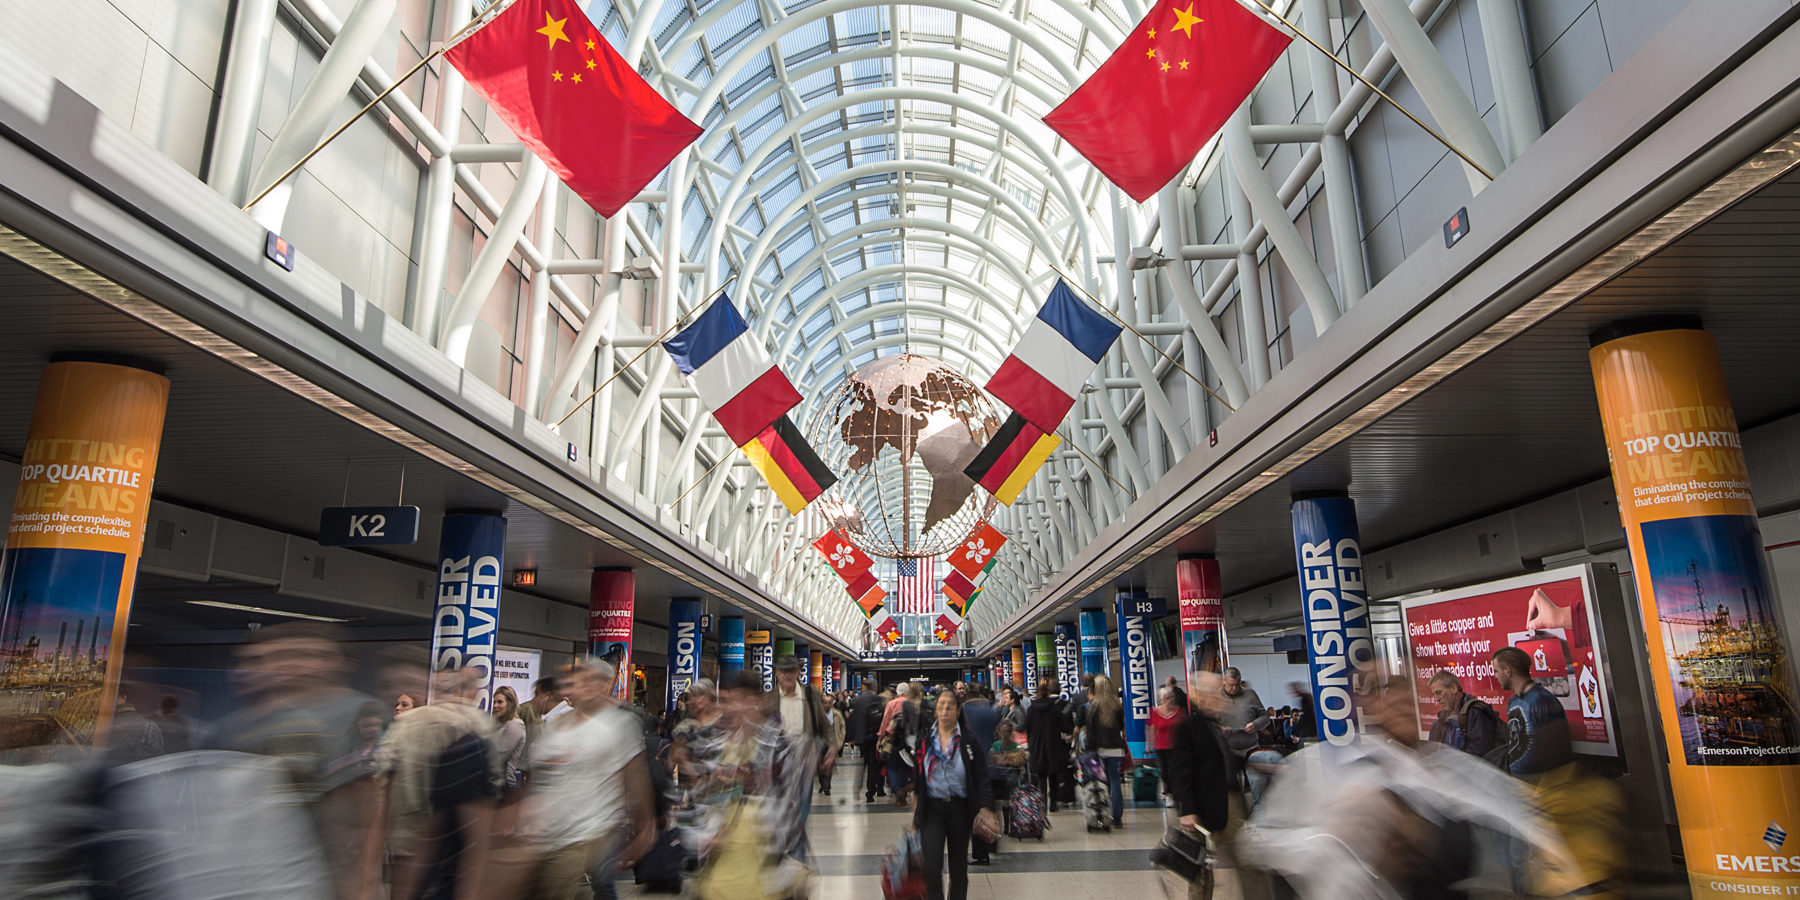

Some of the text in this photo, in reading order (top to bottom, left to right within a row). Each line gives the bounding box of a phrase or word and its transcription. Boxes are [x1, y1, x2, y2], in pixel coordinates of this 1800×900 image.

[24, 439, 145, 469] HITTING
[1624, 436, 1660, 456] TOP
[20, 465, 44, 480] TOP
[46, 464, 141, 488] QUARTILE
[1633, 482, 1688, 497] Eliminating
[1689, 480, 1707, 490] the
[14, 484, 137, 514] MEANS
[1634, 498, 1652, 508] that
[1654, 492, 1684, 504] derail
[1686, 491, 1723, 502] project
[19, 522, 42, 532] derail
[44, 523, 83, 534] project
[84, 525, 130, 538] schedules
[52, 512, 70, 522] the
[71, 514, 131, 528] complexities
[350, 514, 386, 537] K2
[514, 572, 533, 583] EXIT
[1136, 602, 1153, 613] H3
[1191, 598, 1220, 606] QUARTILE
[432, 555, 470, 671] SIDER
[601, 610, 631, 618] QUARTILE
[1409, 611, 1494, 636] Give a little copper and
[676, 622, 695, 674] RSON
[1302, 538, 1356, 747] CONSIDER
[1416, 639, 1490, 657] show the world your
[763, 646, 773, 692] OLVED
[1026, 652, 1037, 700] MERSON
[1056, 646, 1069, 701] ONSIDE
[1126, 616, 1150, 720] EMERSON
[1416, 664, 1434, 678] heart
[1444, 662, 1465, 677] made
[1466, 661, 1474, 677] of
[1476, 660, 1494, 680] gold
[1716, 854, 1800, 873] EMERS
[1711, 881, 1799, 895] CONSIDER IT
